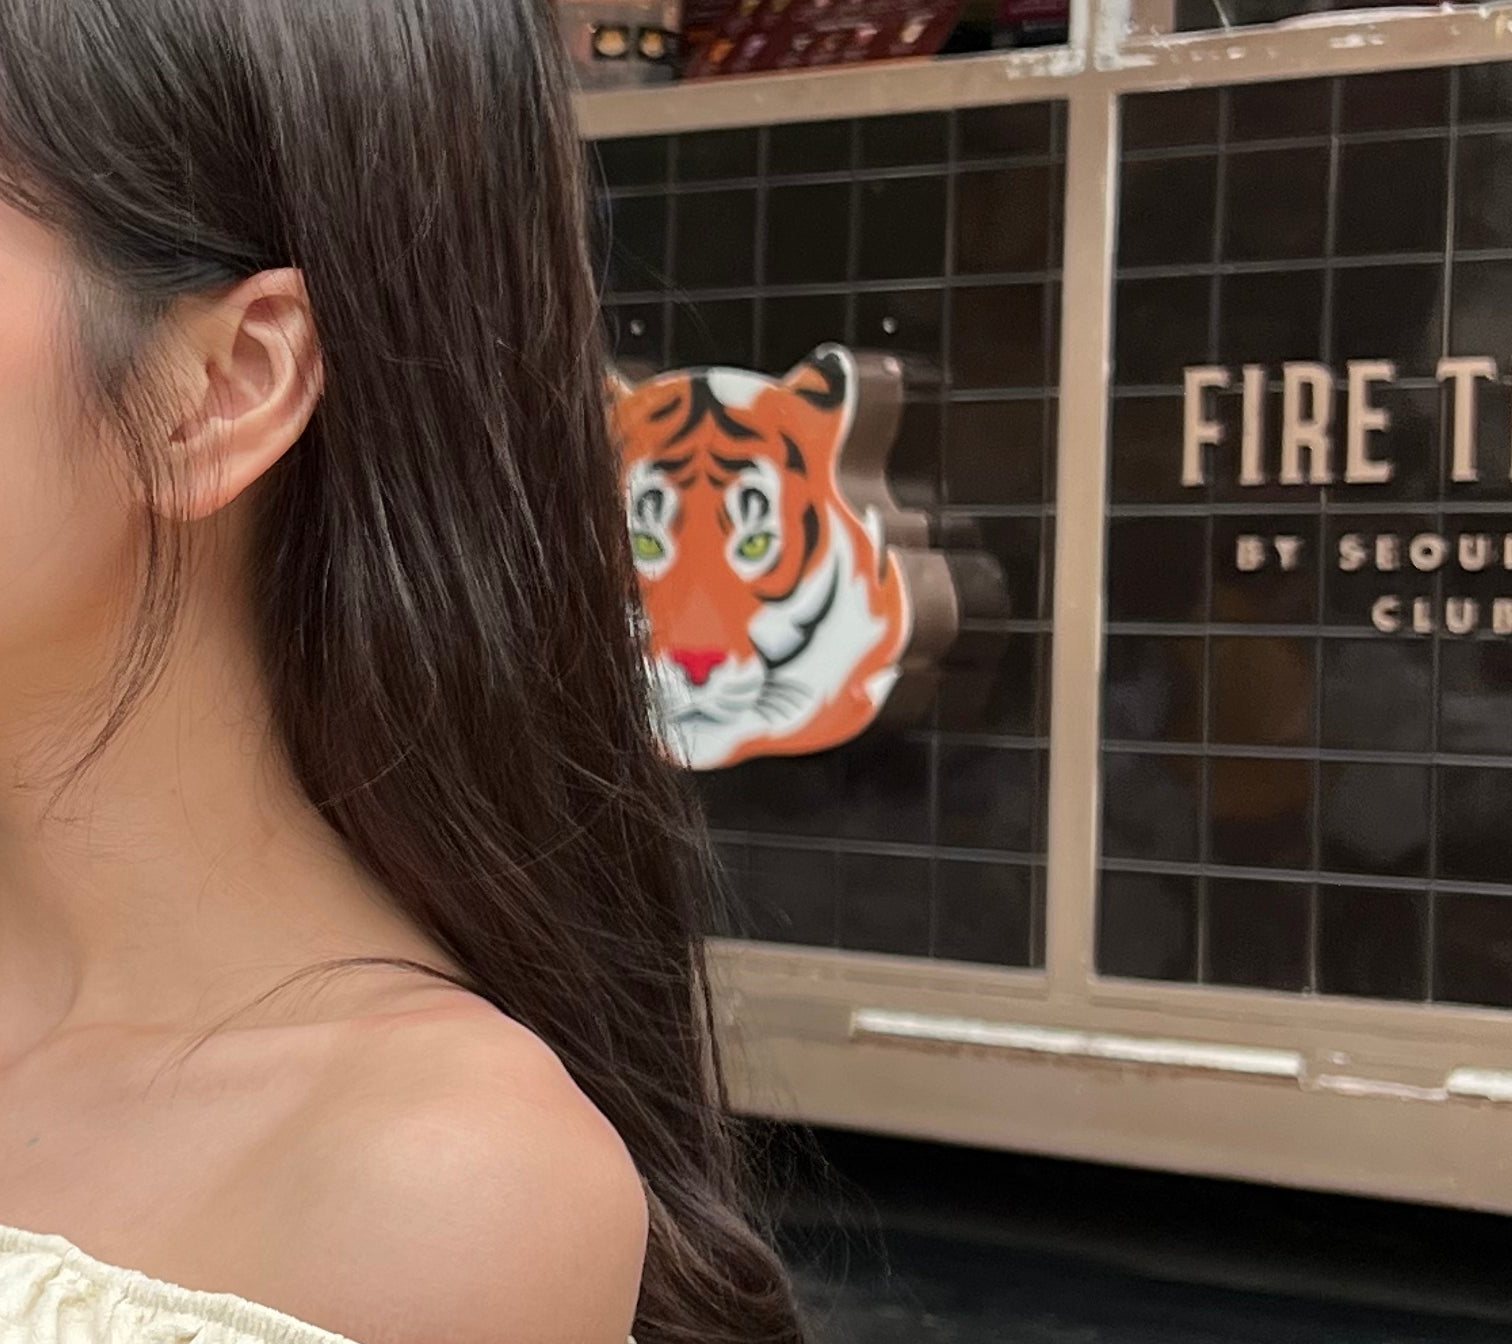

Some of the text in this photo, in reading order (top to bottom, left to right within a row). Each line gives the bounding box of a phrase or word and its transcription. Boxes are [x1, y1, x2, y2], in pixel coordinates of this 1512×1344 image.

[1181, 357, 1512, 487] FIRE T
[1236, 533, 1304, 572] BY
